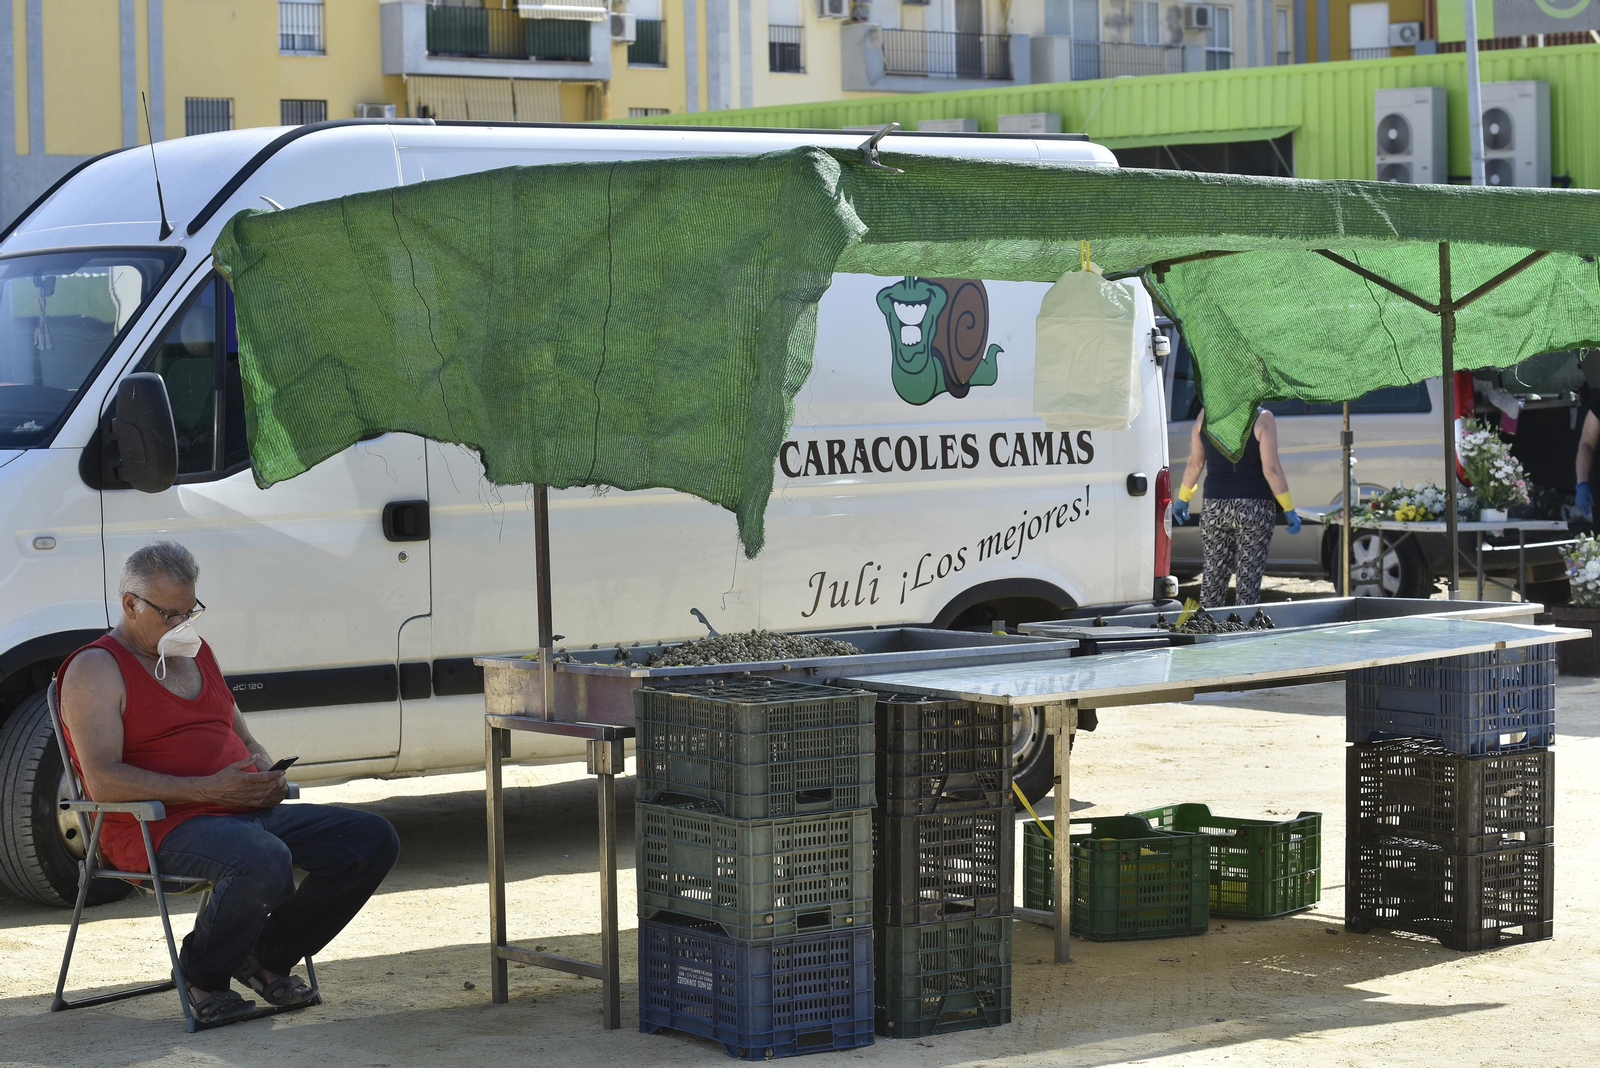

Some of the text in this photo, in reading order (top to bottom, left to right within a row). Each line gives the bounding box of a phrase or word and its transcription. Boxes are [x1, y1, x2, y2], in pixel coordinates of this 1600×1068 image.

[780, 430, 1095, 478] CARACOLES CAMAS
[801, 484, 1091, 618] Juli ¡Los mejores!
